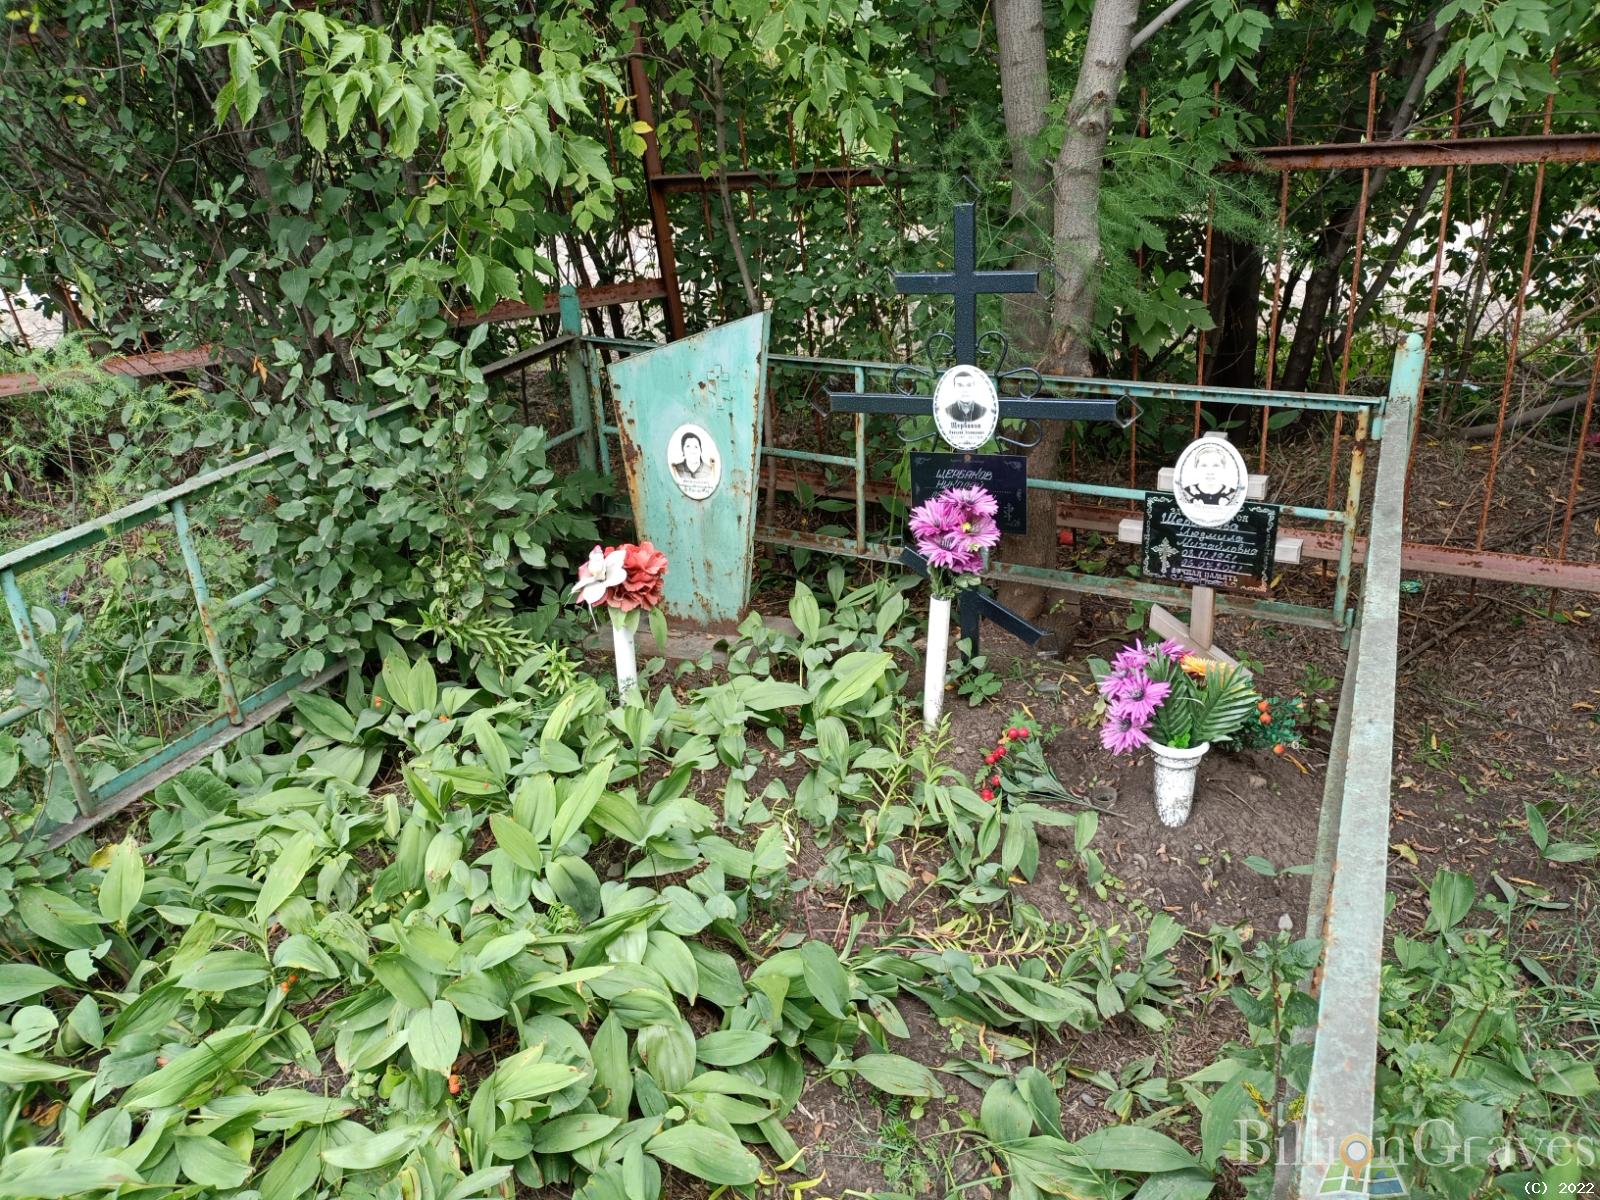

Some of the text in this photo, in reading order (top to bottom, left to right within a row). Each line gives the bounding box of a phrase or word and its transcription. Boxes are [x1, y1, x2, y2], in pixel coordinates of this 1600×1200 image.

[936, 468, 993, 480] ЩЕРБАКОВ
[1179, 528, 1244, 541] Людмила
[1176, 537, 1258, 556] Михайловна
